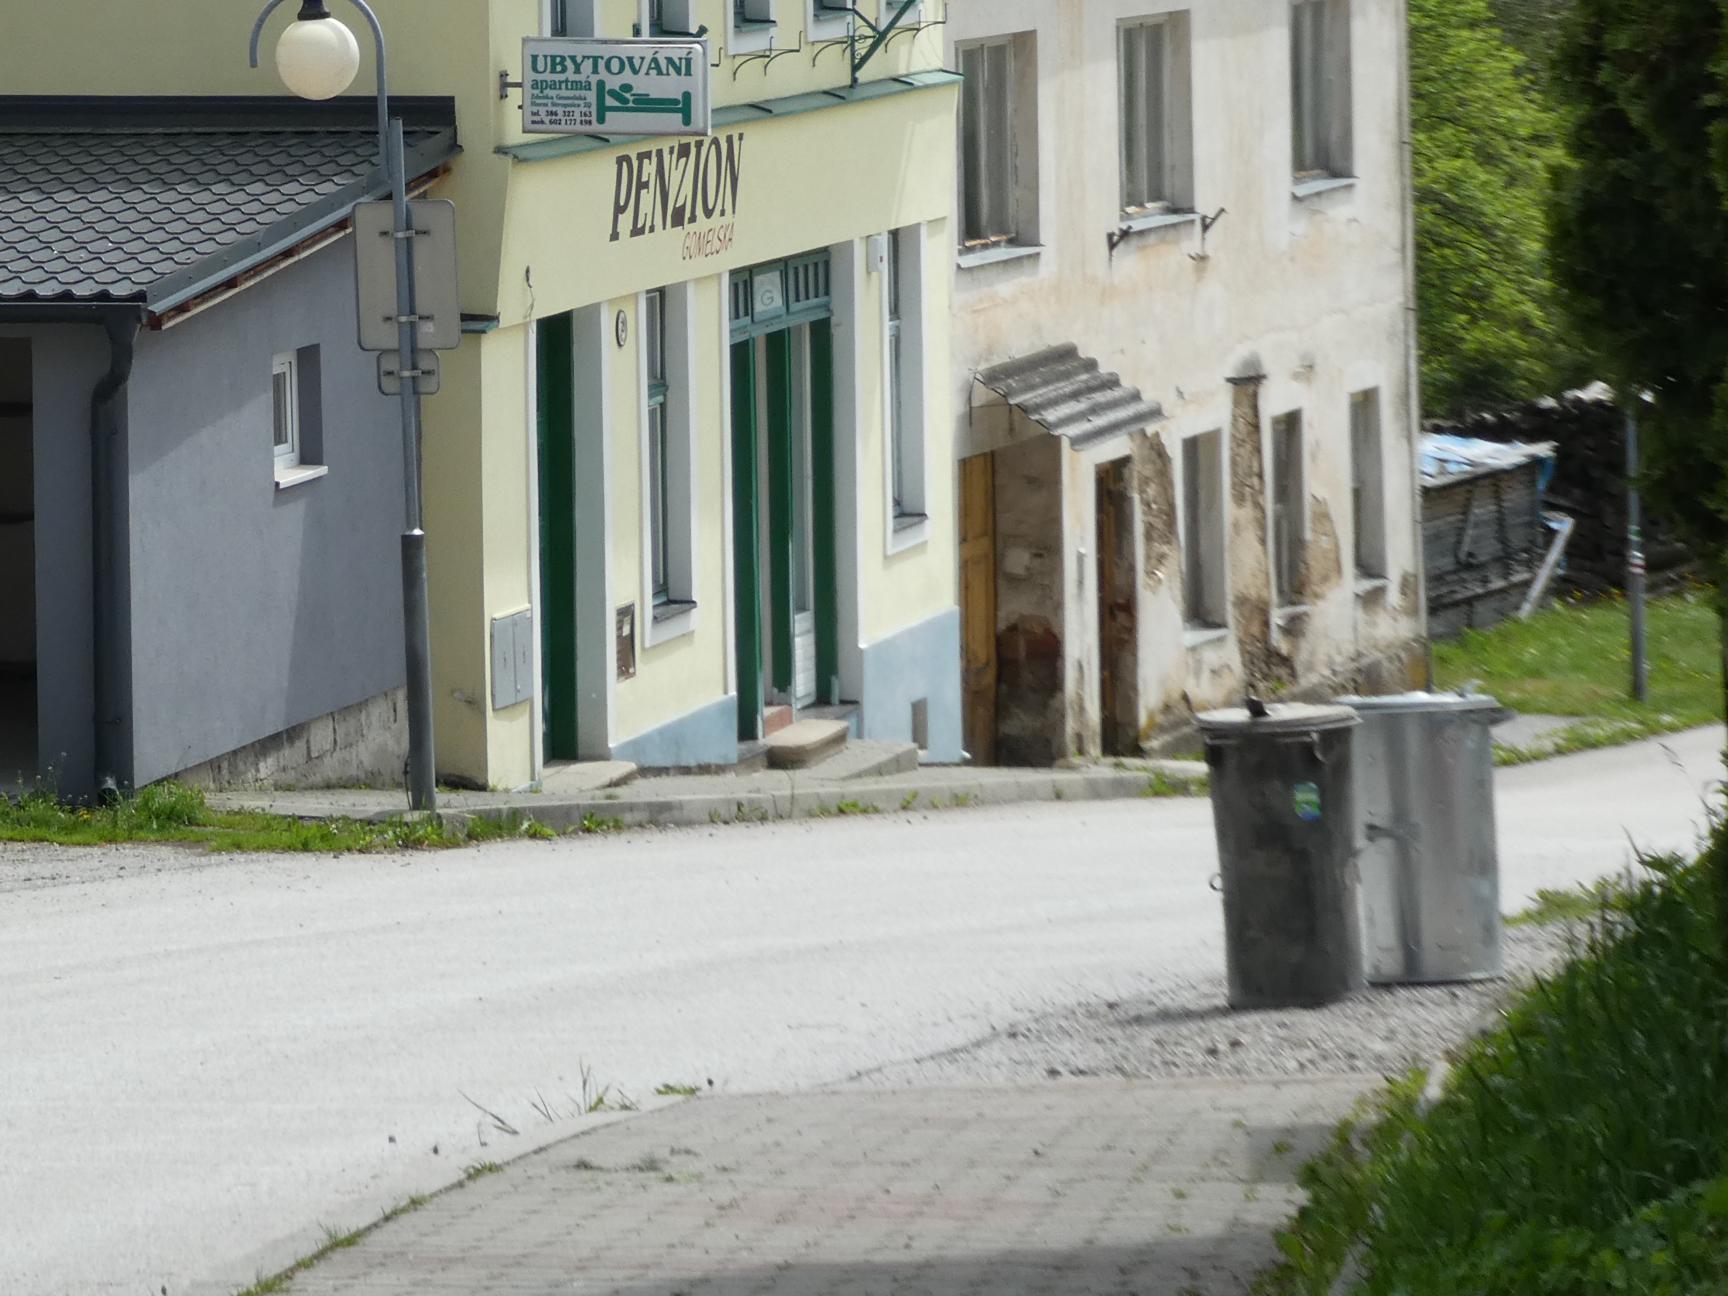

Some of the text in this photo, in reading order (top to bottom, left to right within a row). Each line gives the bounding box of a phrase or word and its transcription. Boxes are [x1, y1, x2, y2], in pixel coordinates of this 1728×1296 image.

[531, 51, 693, 77] UBYTOVÁNÍ
[531, 75, 593, 94] apartmá
[608, 132, 744, 242] PENZION
